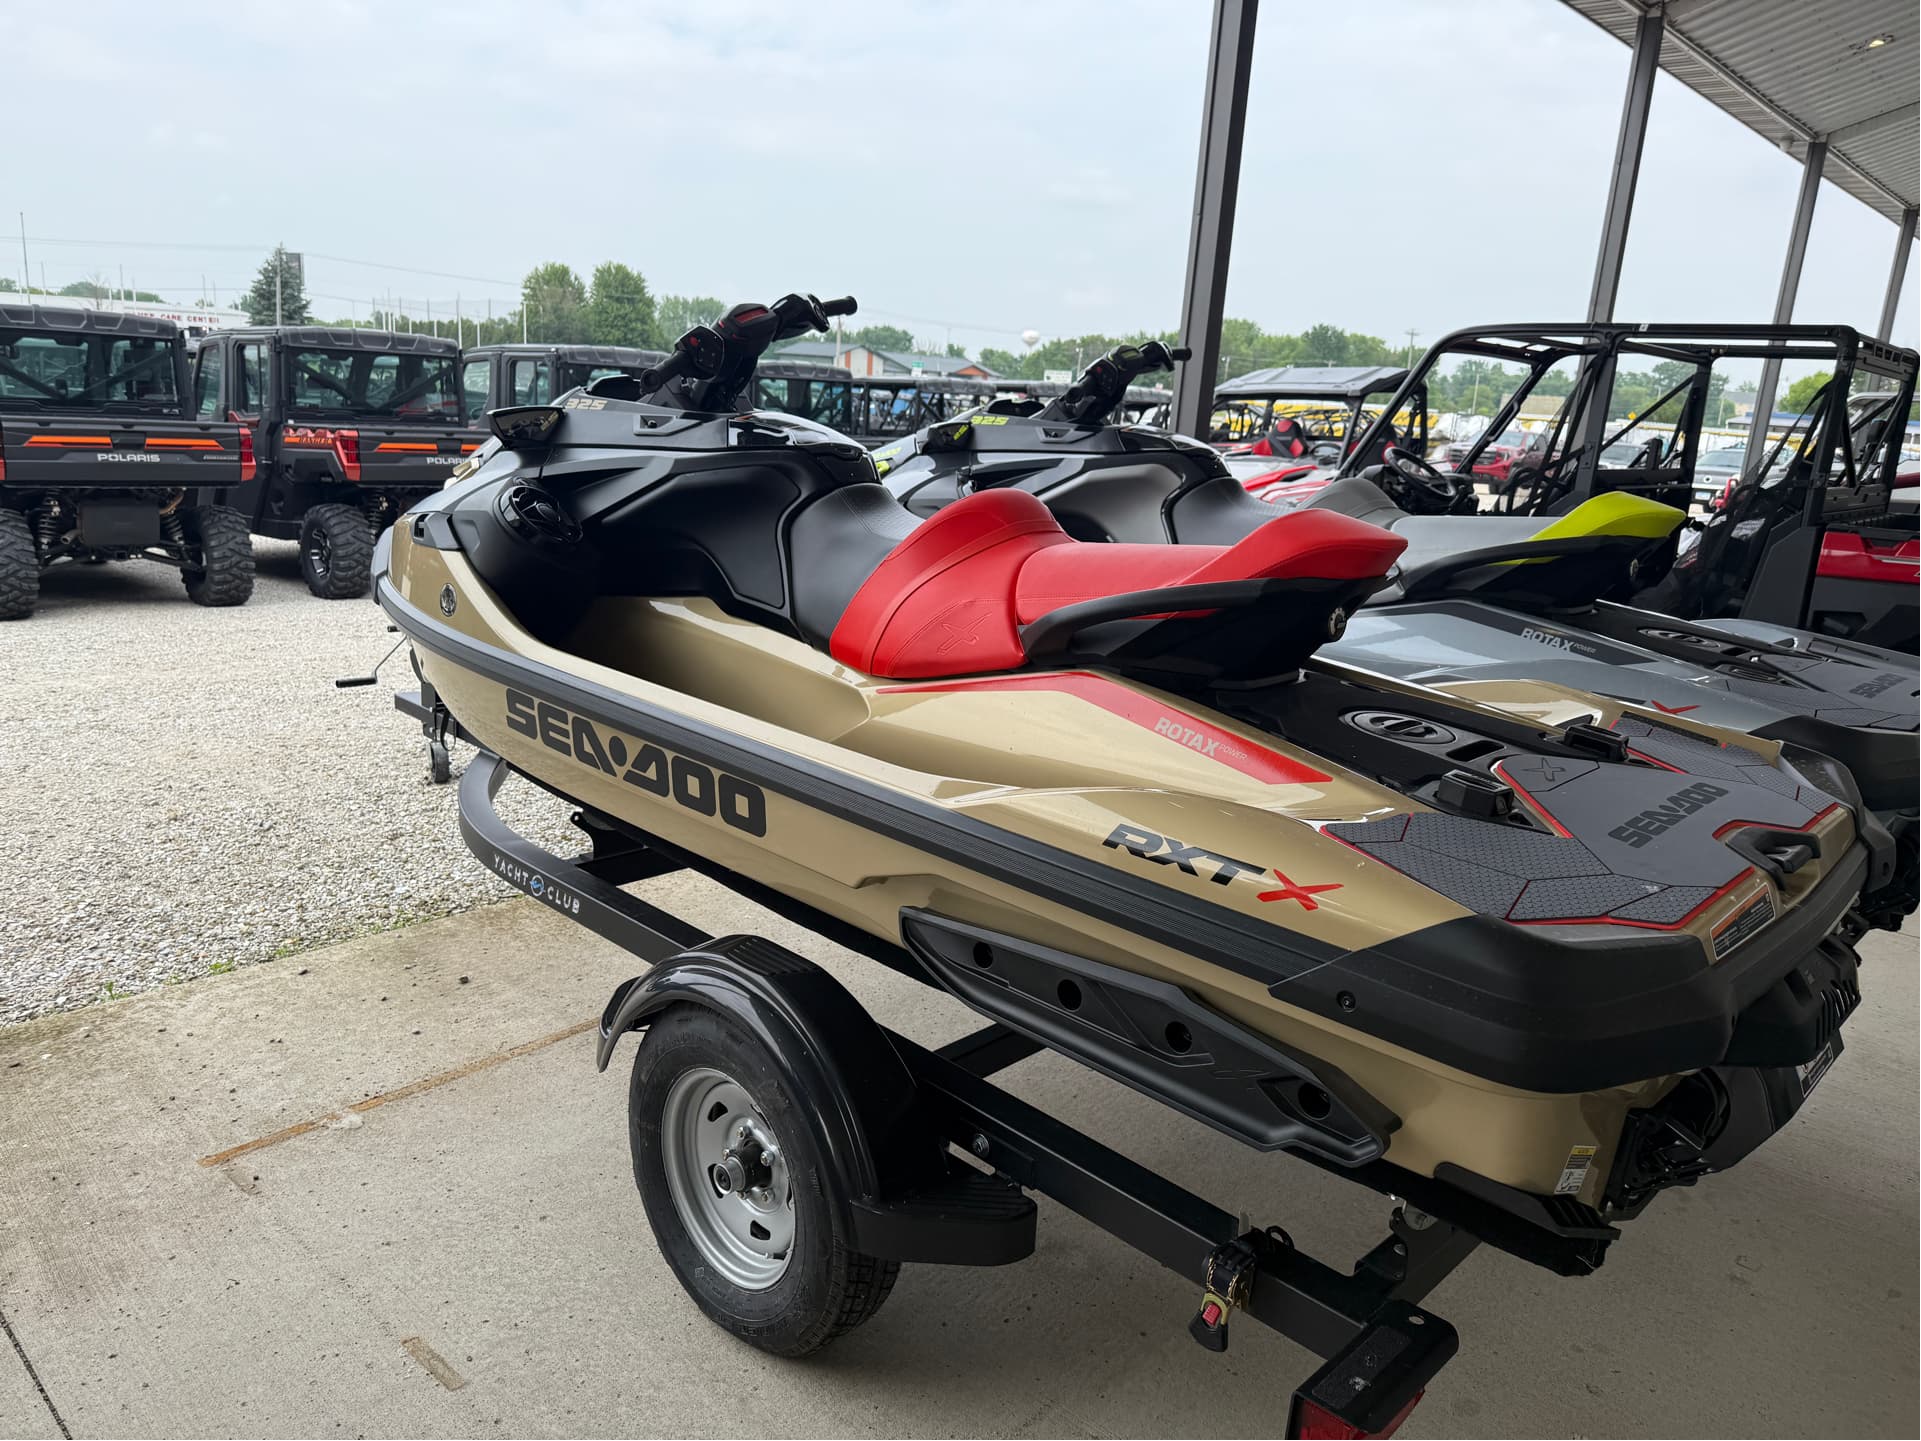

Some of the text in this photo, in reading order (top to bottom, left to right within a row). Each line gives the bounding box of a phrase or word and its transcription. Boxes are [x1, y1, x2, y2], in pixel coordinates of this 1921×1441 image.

[566, 398, 608, 410] 325
[971, 415, 1009, 426] 325
[97, 453, 161, 463] POLARIS
[1520, 627, 1575, 653] ROTAX
[1154, 716, 1248, 761] ROTAX POWER
[1102, 823, 1267, 886] RXT
[494, 854, 580, 914] YACHT CLUB
